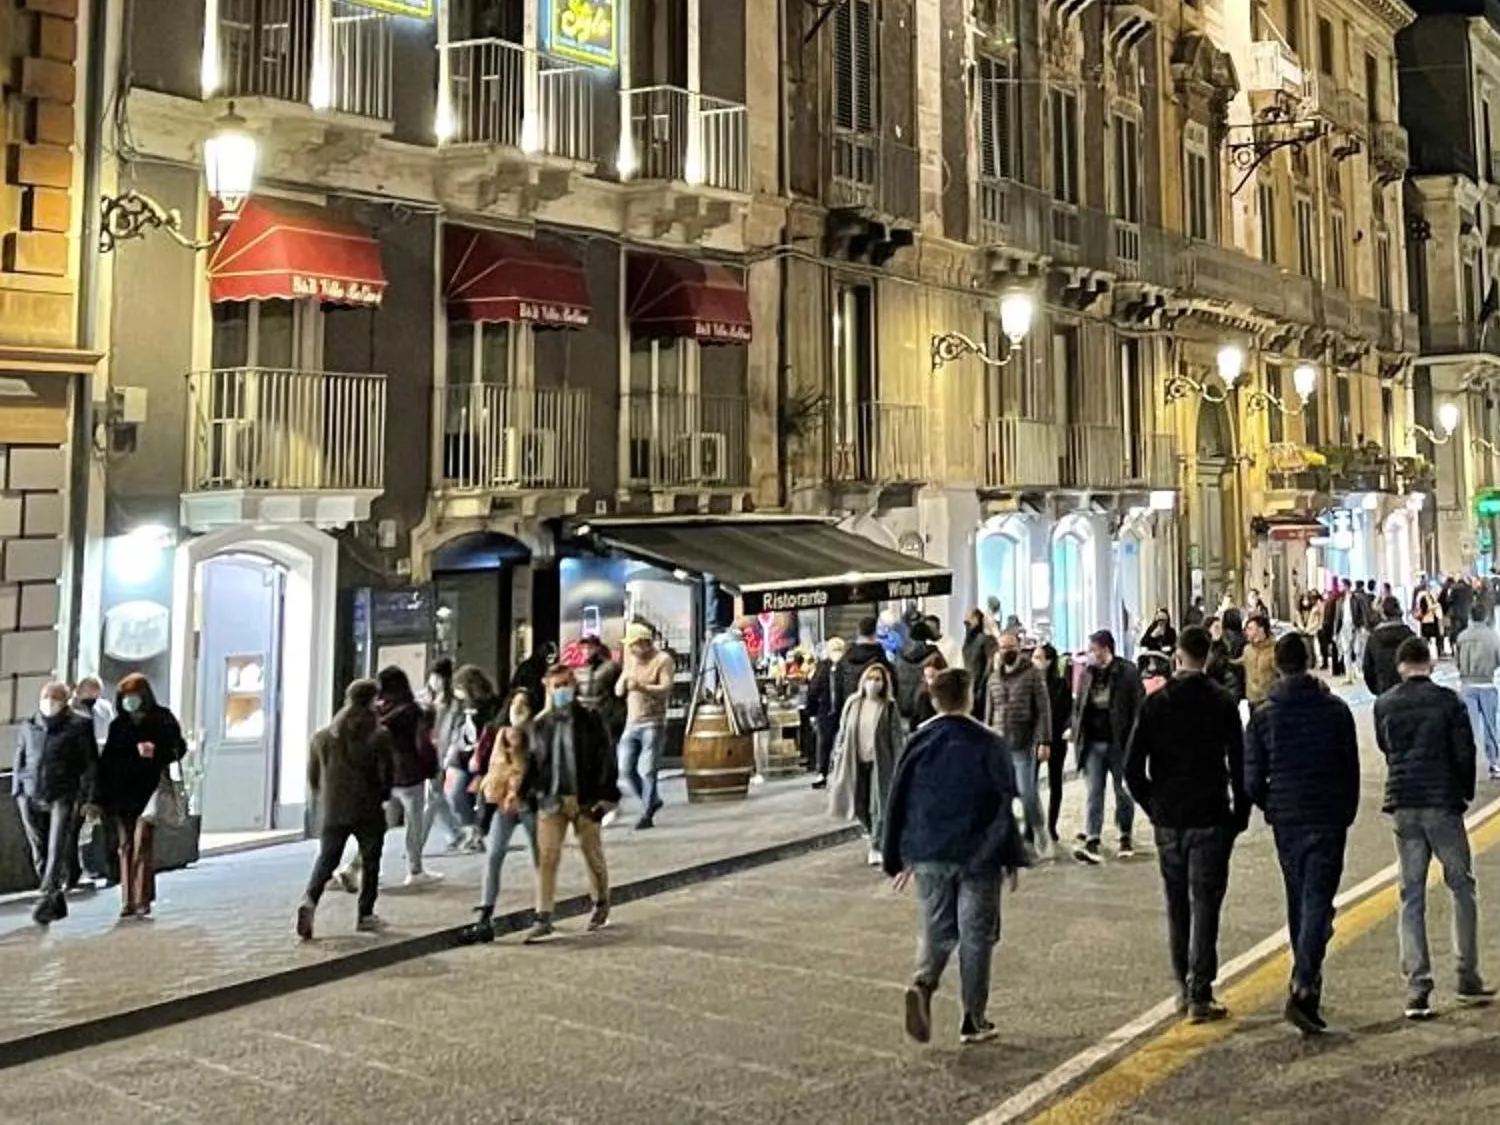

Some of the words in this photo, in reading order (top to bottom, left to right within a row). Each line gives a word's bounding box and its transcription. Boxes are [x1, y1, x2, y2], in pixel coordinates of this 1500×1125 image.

[762, 589, 829, 610] Ristorante
[887, 577, 912, 596] Wine
[914, 577, 931, 595] bar
